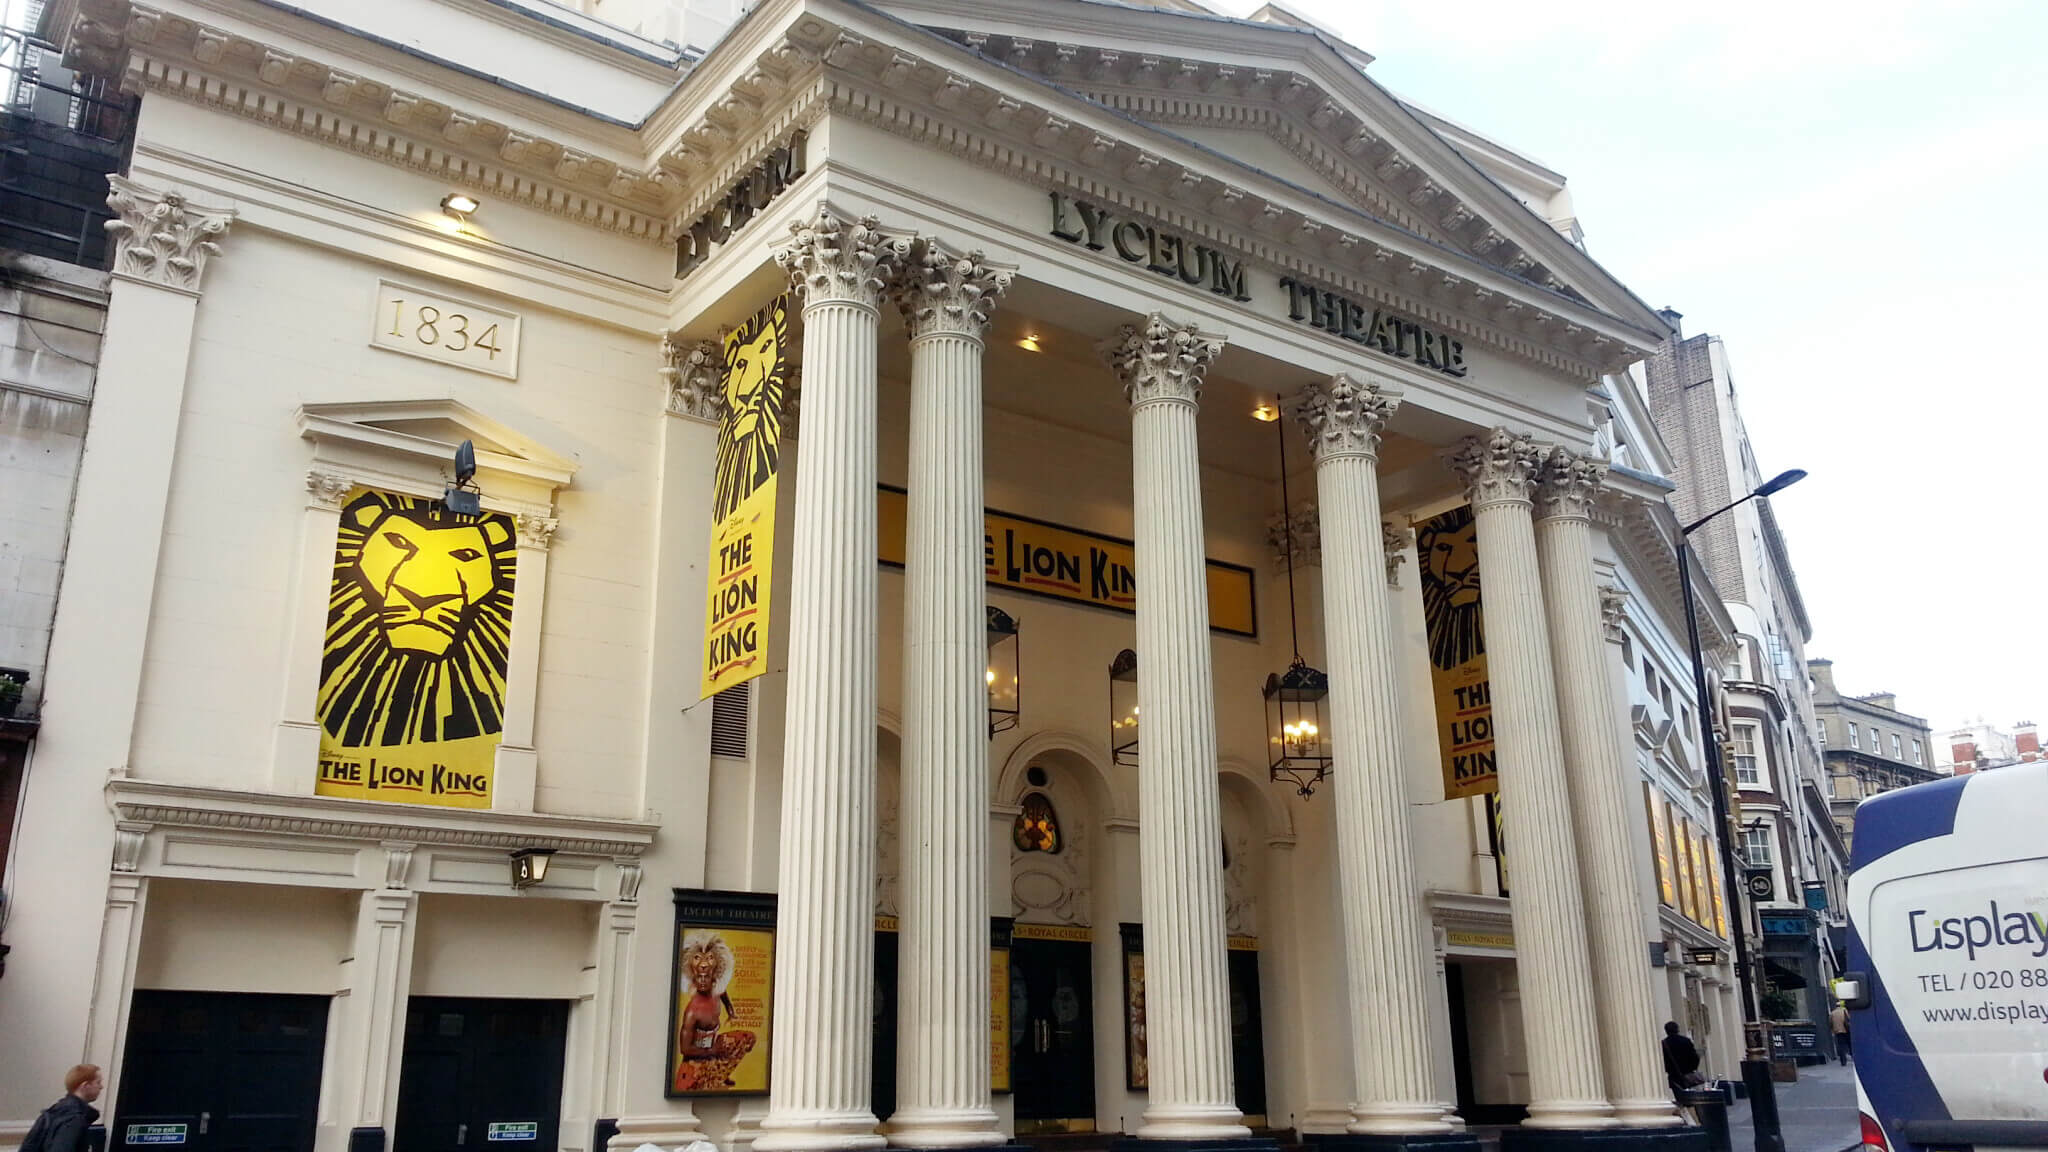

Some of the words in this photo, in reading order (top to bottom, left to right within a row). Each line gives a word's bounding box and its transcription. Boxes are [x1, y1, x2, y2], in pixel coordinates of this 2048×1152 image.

[1049, 192, 1252, 302] LYCEUM
[1280, 276, 1467, 377] THEATRE
[387, 300, 501, 360] 1834
[719, 533, 752, 576] THE
[1006, 529, 1080, 583] LION
[1090, 547, 1136, 600] KIN
[713, 575, 757, 624] LION
[709, 621, 757, 671] KING
[320, 760, 361, 781] THE
[368, 758, 424, 789] LION
[431, 764, 487, 794] KING
[1453, 750, 1497, 780] KIN
[1918, 974, 1955, 992] TEL
[1960, 972, 1966, 990] /
[1973, 970, 2014, 990] 020
